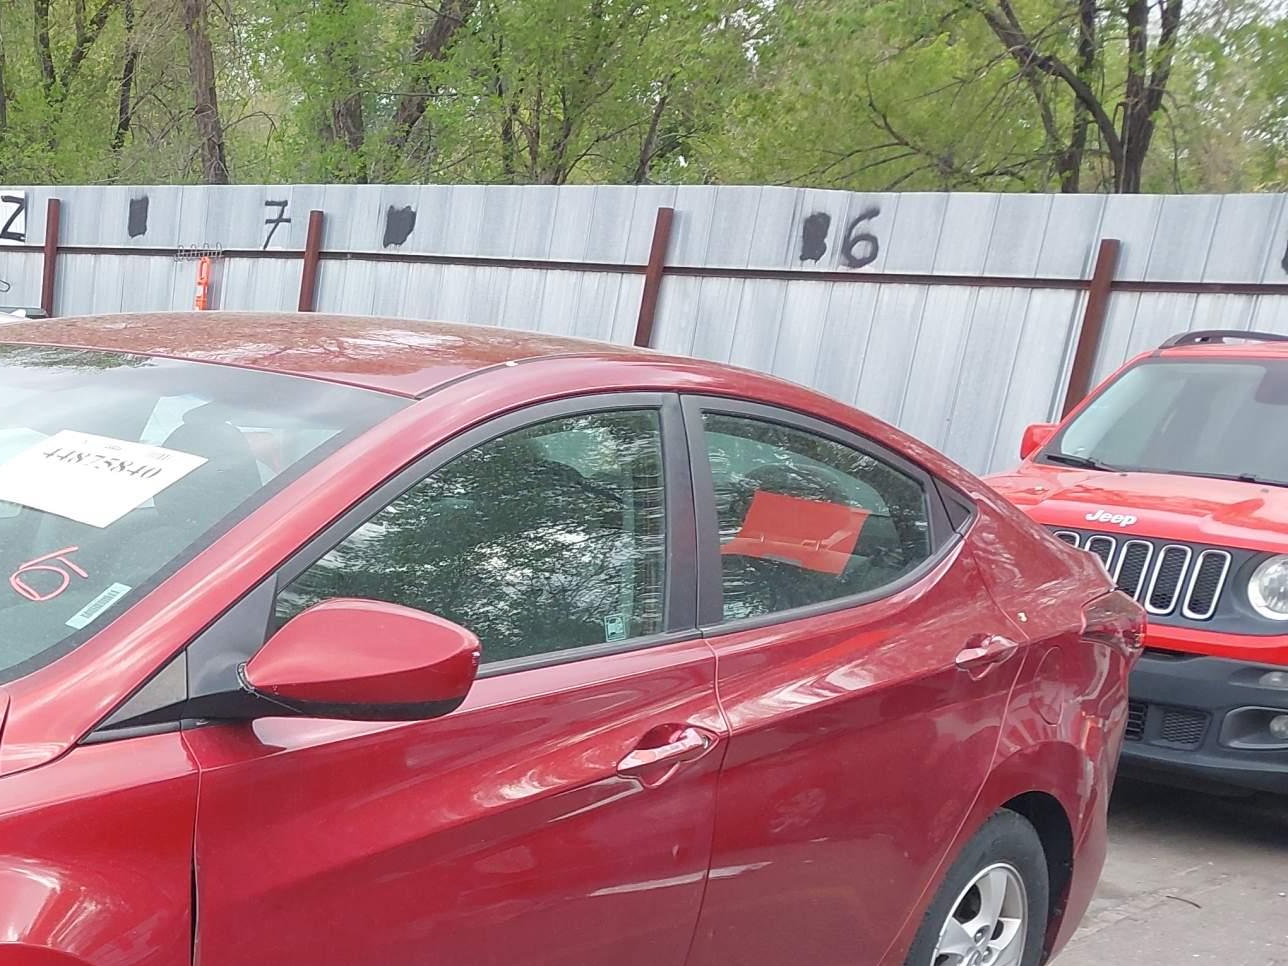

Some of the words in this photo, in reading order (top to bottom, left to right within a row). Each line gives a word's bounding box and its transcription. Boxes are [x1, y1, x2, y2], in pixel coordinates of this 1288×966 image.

[263, 200, 292, 250] 7
[841, 207, 880, 269] 6
[1085, 509, 1138, 528] Jeep
